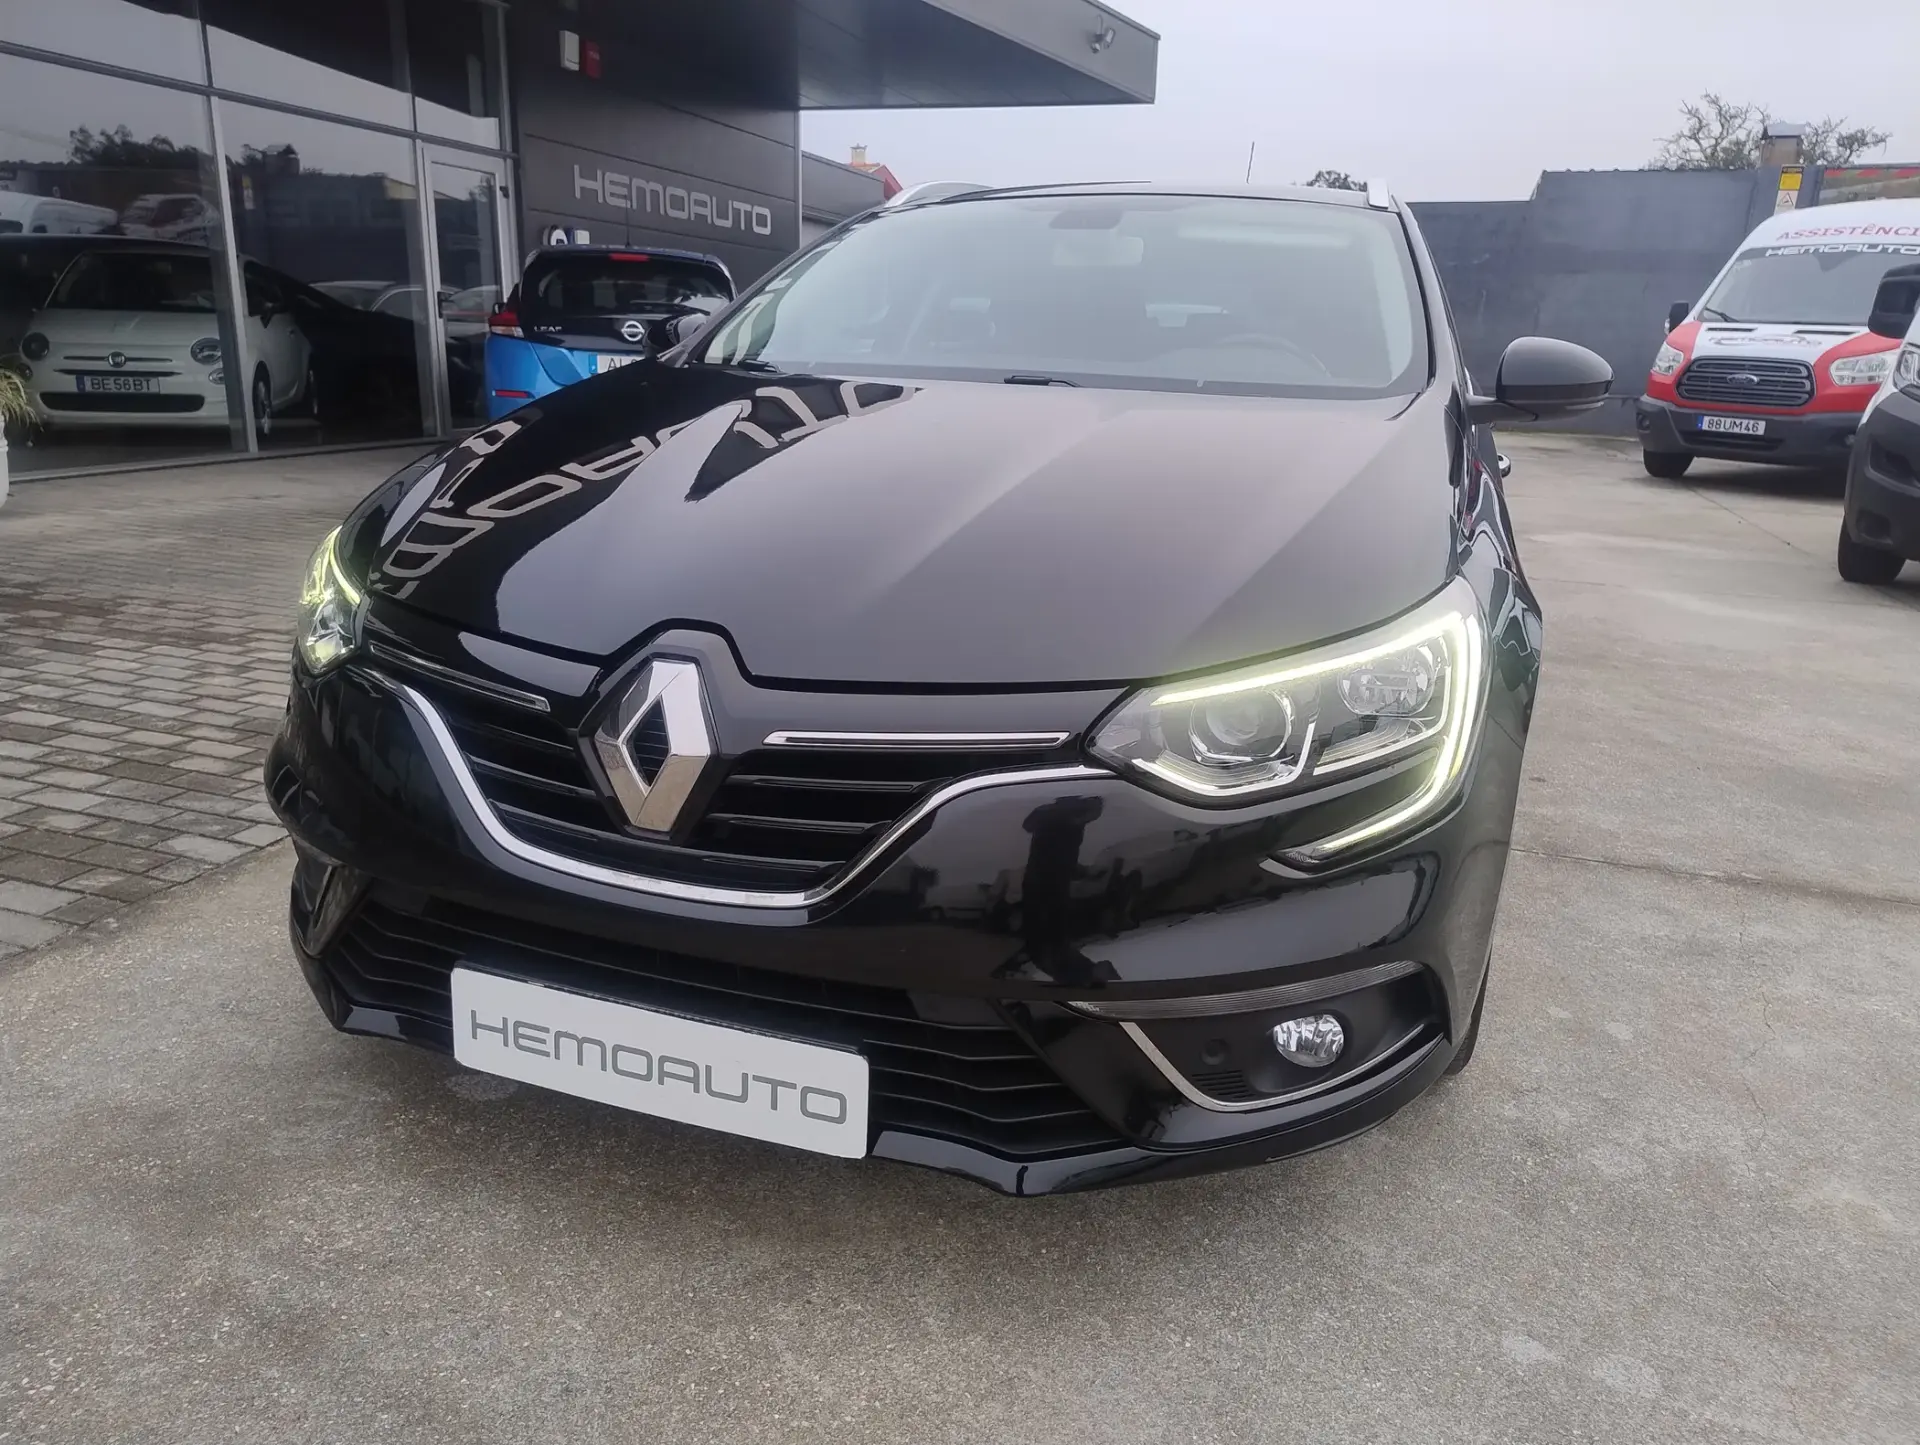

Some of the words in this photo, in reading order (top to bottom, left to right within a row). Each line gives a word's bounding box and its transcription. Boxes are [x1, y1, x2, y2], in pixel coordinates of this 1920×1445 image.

[573, 164, 771, 235] HEMOAUTO
[1765, 244, 1920, 257] HEMOAUTO
[533, 325, 562, 333] LEAF
[1707, 418, 1760, 434] 88UM46
[470, 1009, 848, 1126] HEMOAUTO
